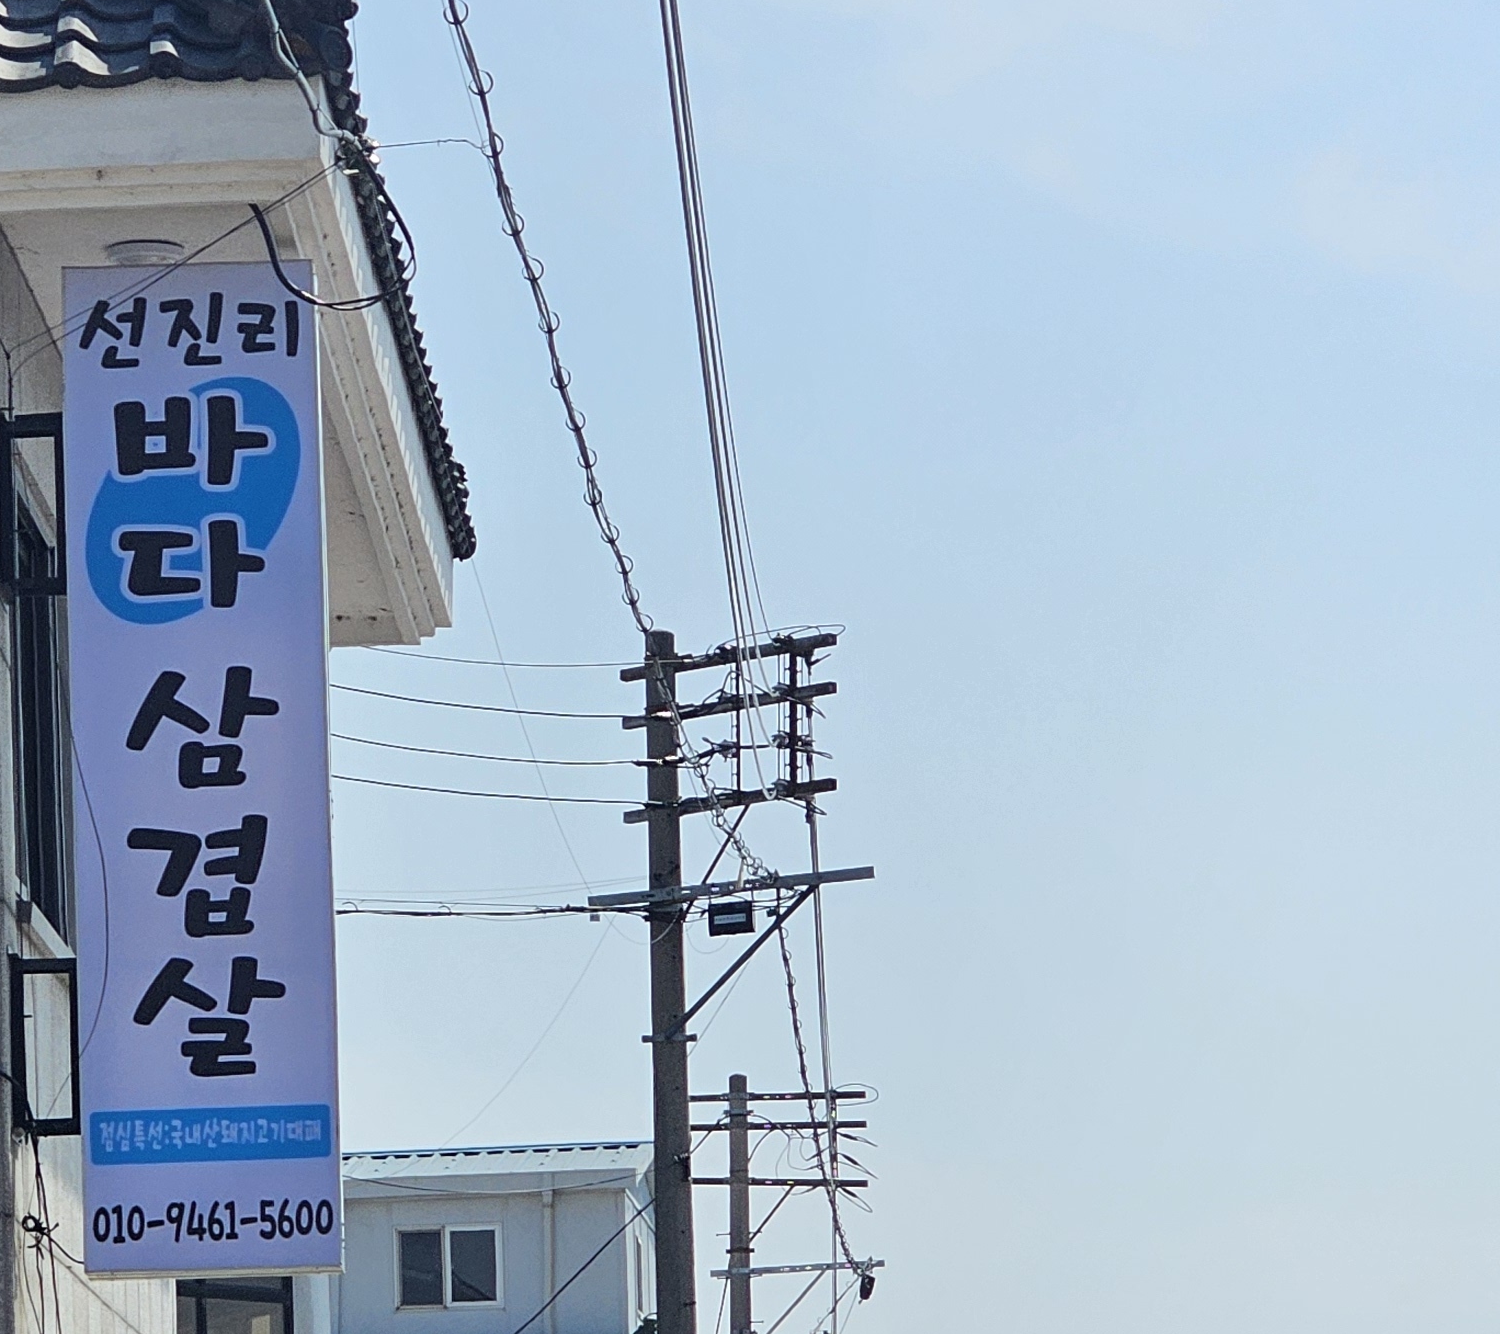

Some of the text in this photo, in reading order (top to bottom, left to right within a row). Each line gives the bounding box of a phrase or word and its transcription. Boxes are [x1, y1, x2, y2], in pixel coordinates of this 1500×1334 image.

[79, 292, 299, 369] 선진리
[113, 395, 286, 1077] 바다 삼겹살
[93, 1198, 333, 1243] 010-9461-5600
